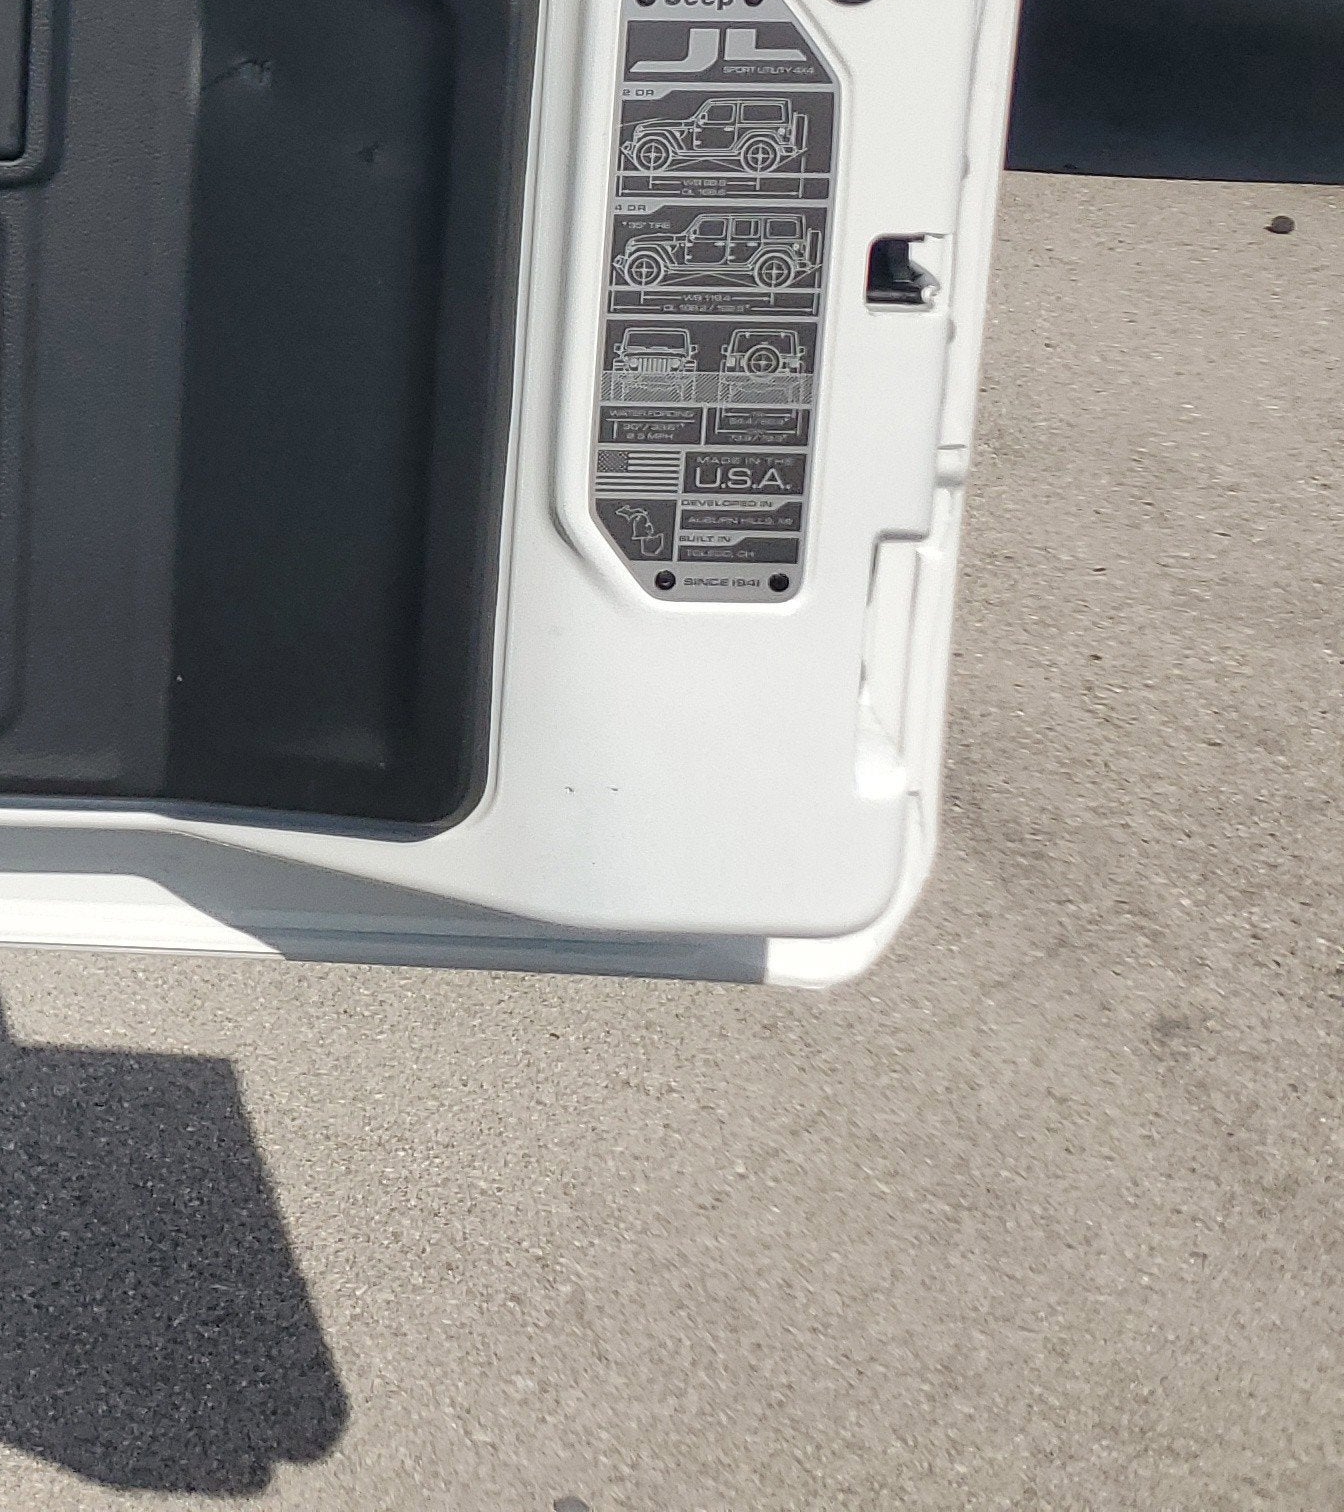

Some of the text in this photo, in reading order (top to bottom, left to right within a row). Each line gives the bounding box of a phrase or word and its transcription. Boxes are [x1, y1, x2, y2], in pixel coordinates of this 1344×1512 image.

[629, 28, 807, 73] JL
[722, 66, 755, 75] SPORT
[757, 66, 792, 75] UTILITY
[622, 88, 654, 97] 2 DR
[627, 204, 647, 212] DR
[696, 456, 794, 466] MADE IN THE
[695, 467, 792, 490] U.S.A.
[680, 499, 773, 508] DEVELOPED IN
[687, 516, 740, 525] AUBURN
[679, 535, 715, 543] BUILT
[683, 577, 761, 588] SINCE 1941
